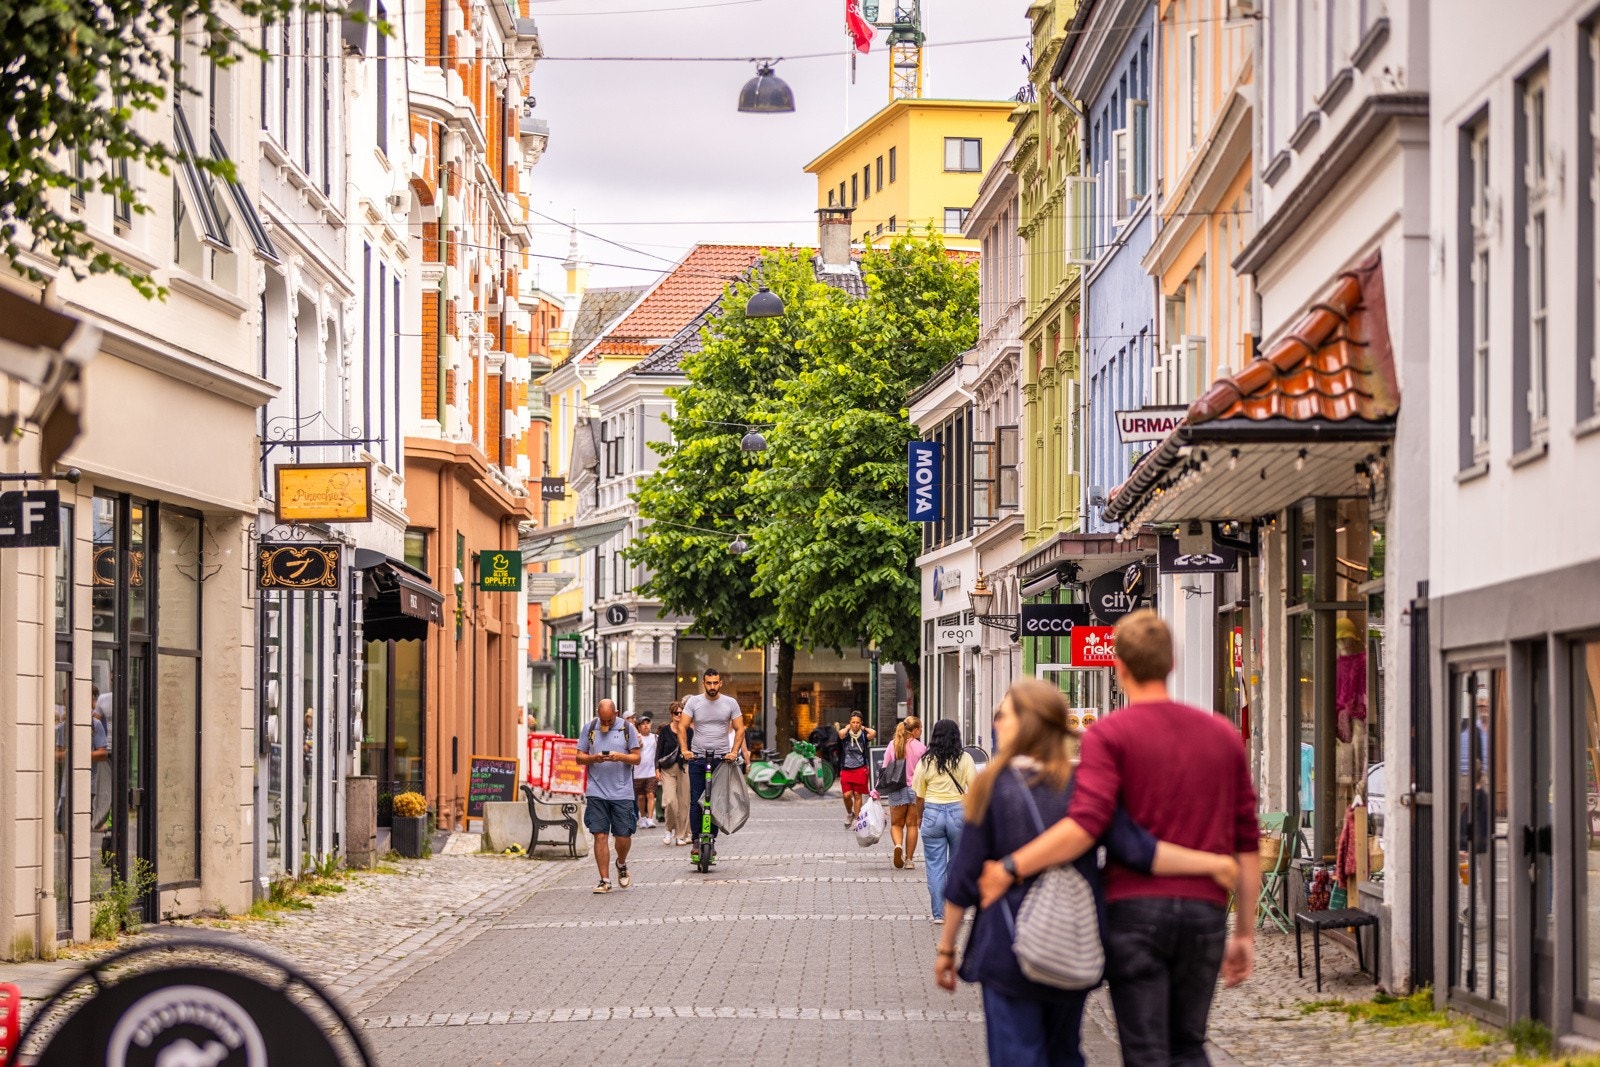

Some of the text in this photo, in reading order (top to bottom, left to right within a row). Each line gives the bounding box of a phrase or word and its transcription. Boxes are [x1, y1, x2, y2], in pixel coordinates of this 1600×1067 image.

[915, 448, 933, 514] MOVA
[484, 575, 515, 583] OPPLETT
[1101, 590, 1138, 612] city
[613, 608, 624, 623] b
[1026, 618, 1075, 632] ecco
[942, 629, 974, 644] regn
